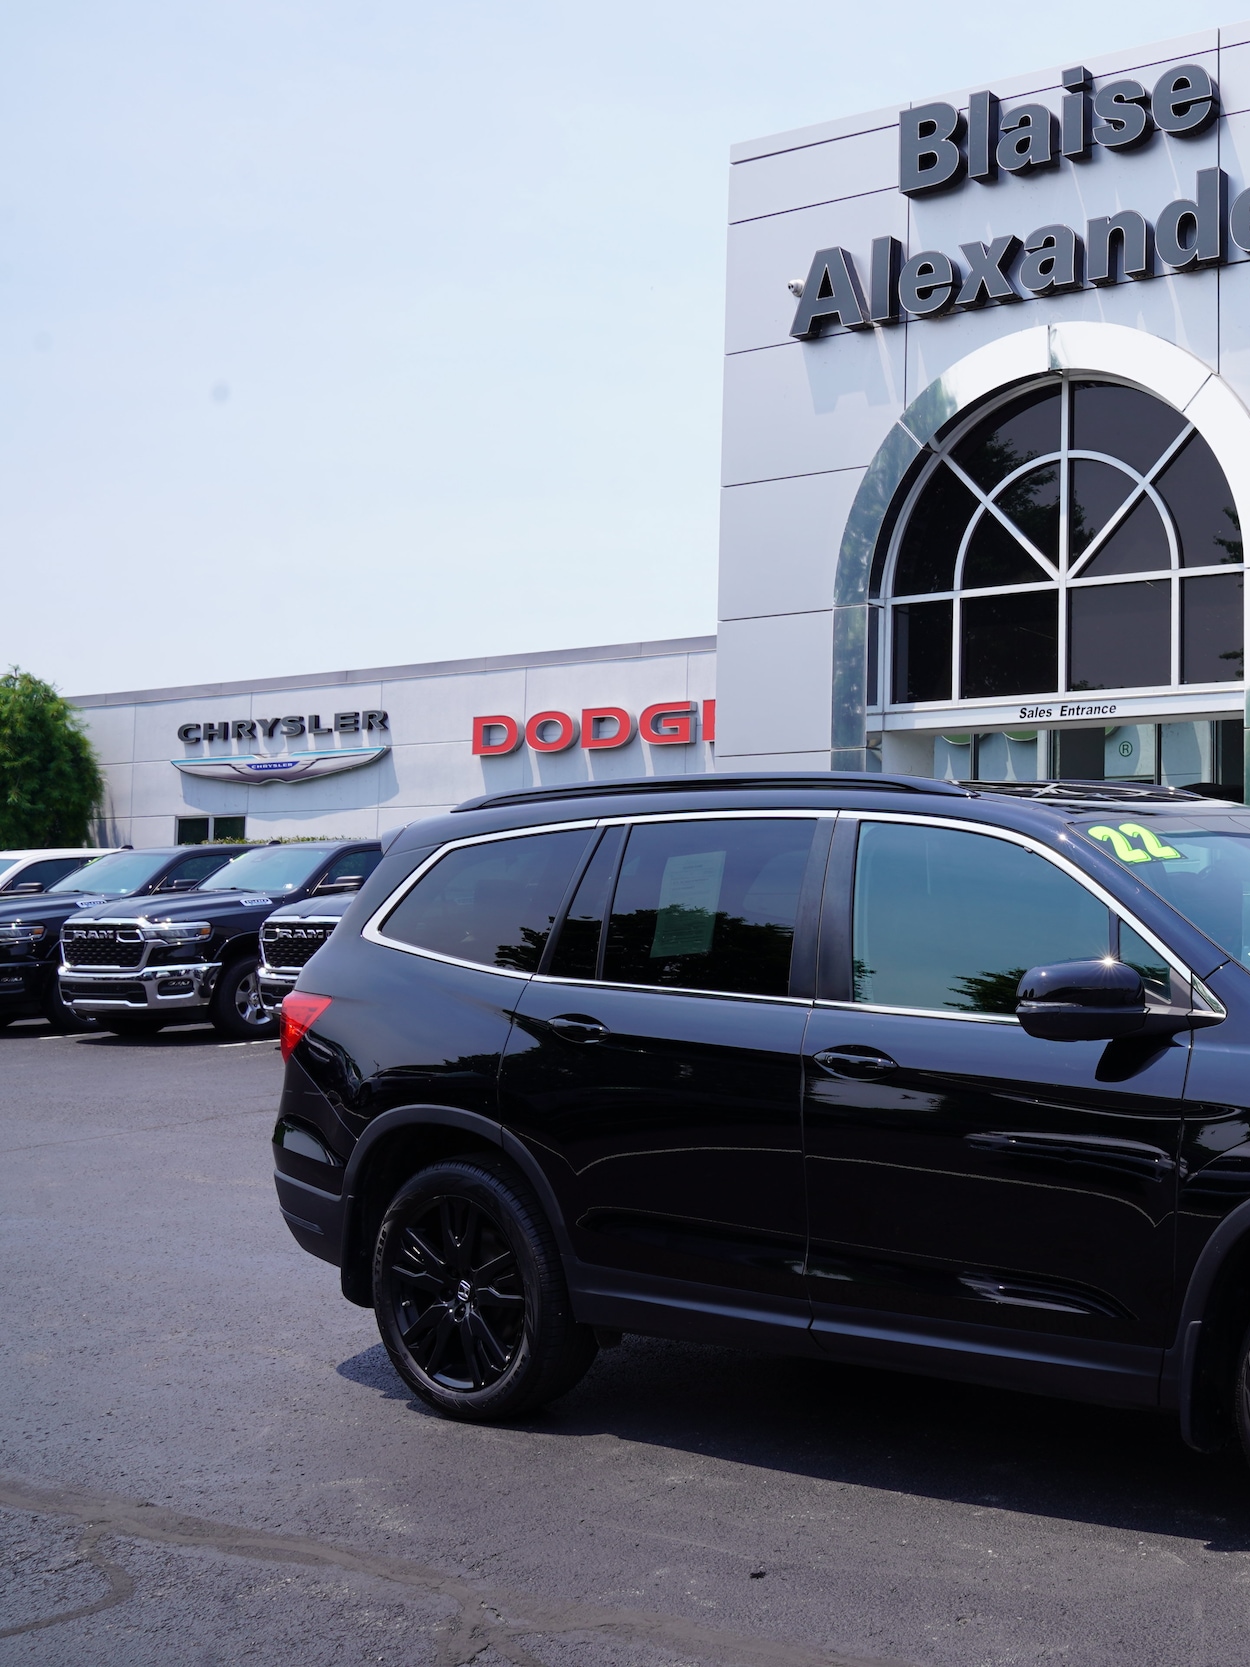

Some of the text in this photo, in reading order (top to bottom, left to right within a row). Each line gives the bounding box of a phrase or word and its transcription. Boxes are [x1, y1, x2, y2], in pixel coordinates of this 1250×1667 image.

[899, 63, 1220, 200] Blaise
[1019, 704, 1117, 719] Sales Entrance
[177, 709, 389, 744] CHRYSLER
[251, 762, 293, 770] CHRYSLER
[1087, 823, 1181, 863] 22
[73, 930, 114, 939] RAM
[278, 929, 324, 939] RAM
